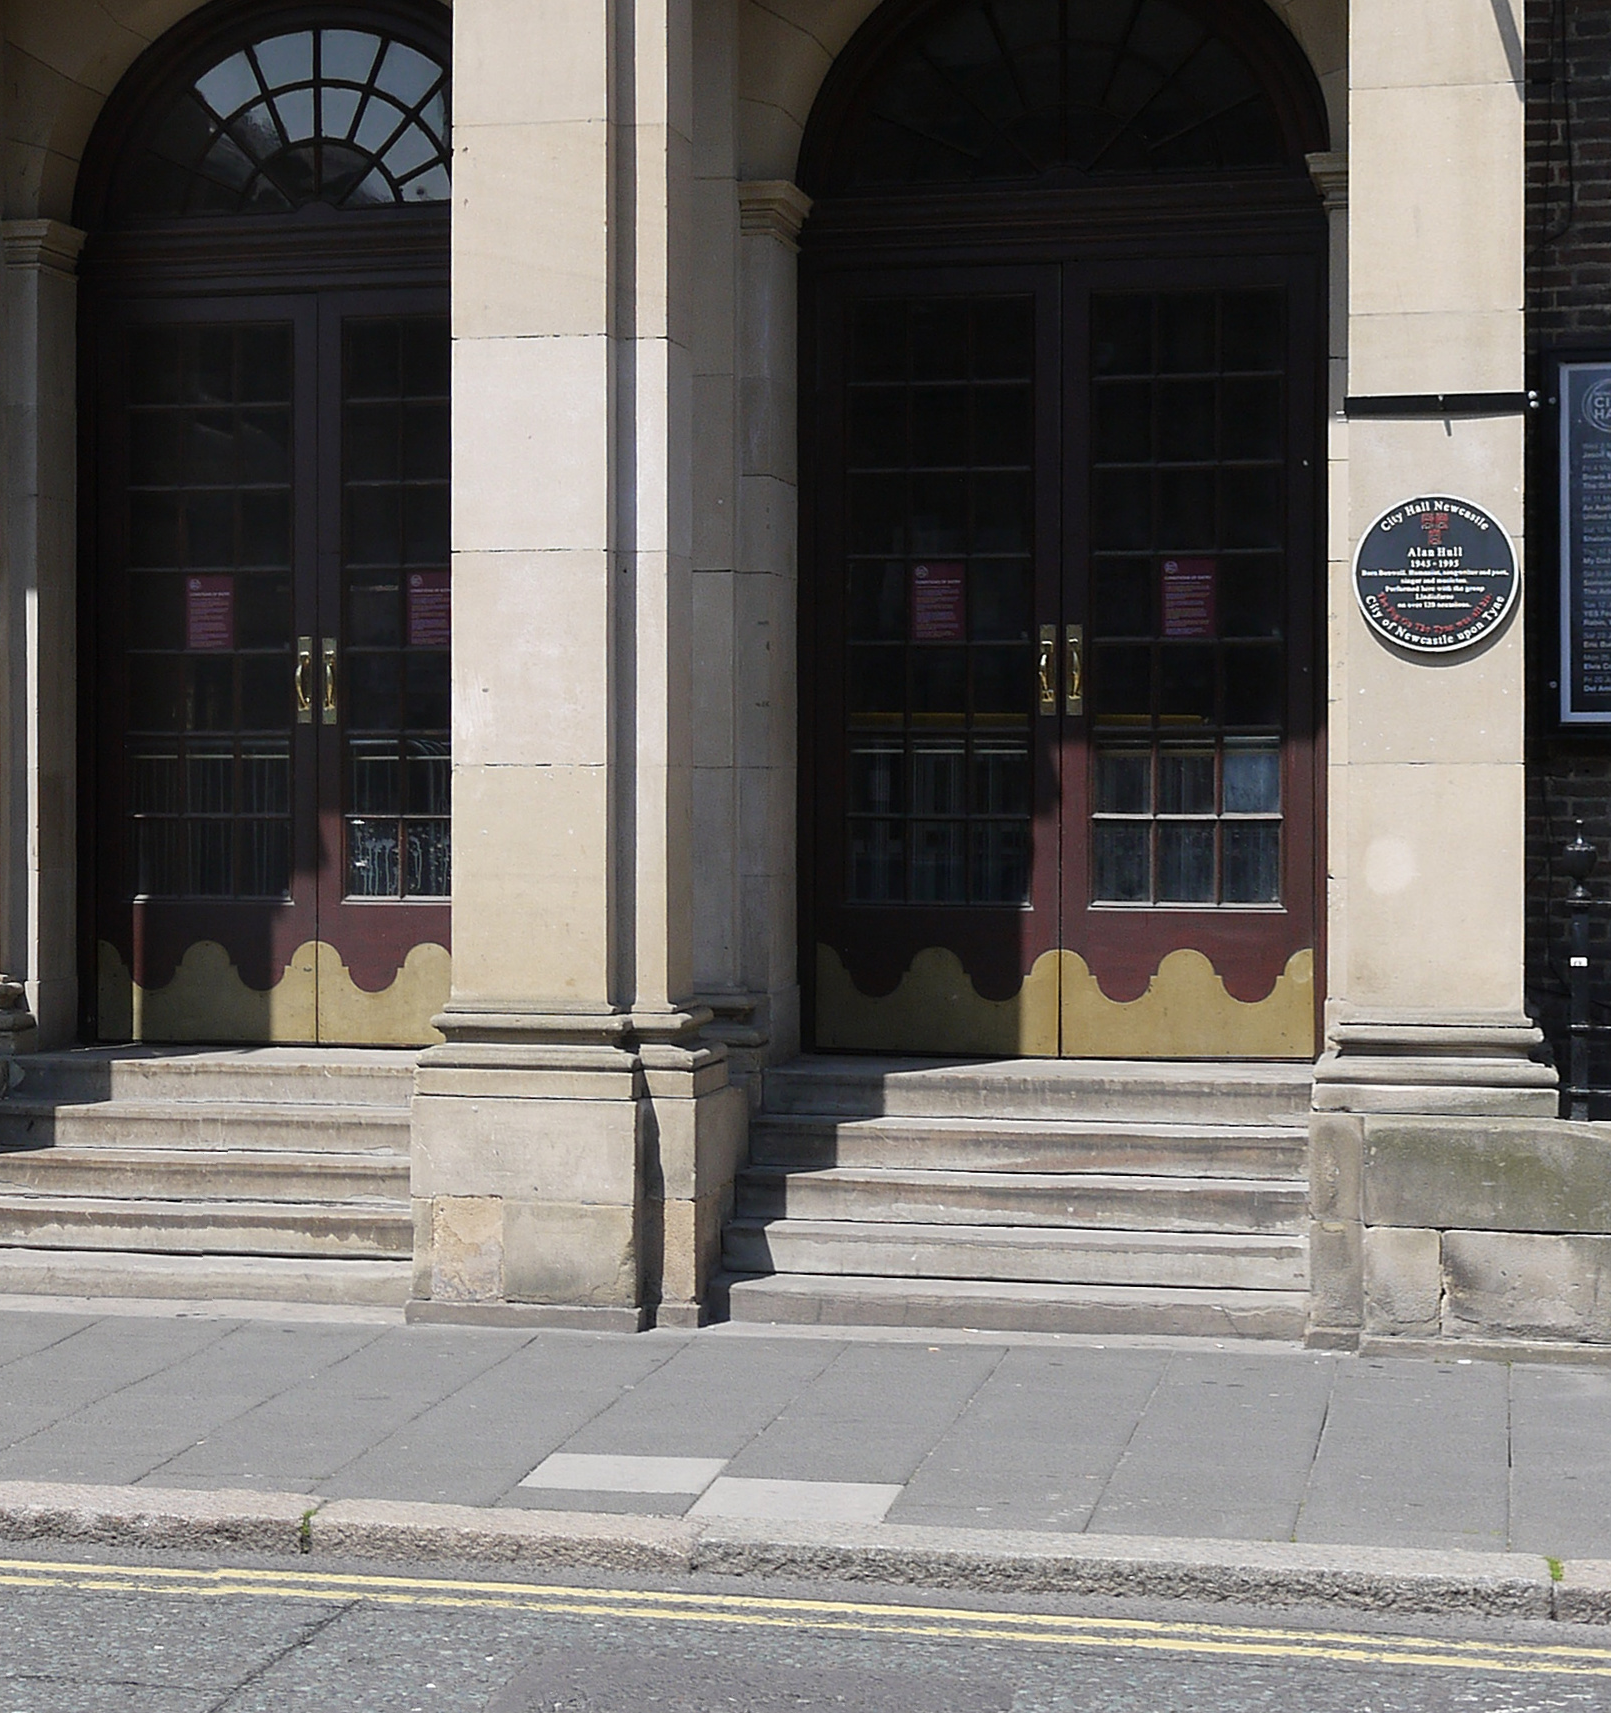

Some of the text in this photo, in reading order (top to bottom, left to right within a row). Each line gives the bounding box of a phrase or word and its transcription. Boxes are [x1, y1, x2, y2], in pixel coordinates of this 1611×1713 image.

[1380, 501, 1490, 532] City Hall Newcastle
[1407, 547, 1434, 557] Alan
[1365, 595, 1383, 618] City
[1395, 625, 1454, 645] Newcastle
[1458, 621, 1485, 640] upon
